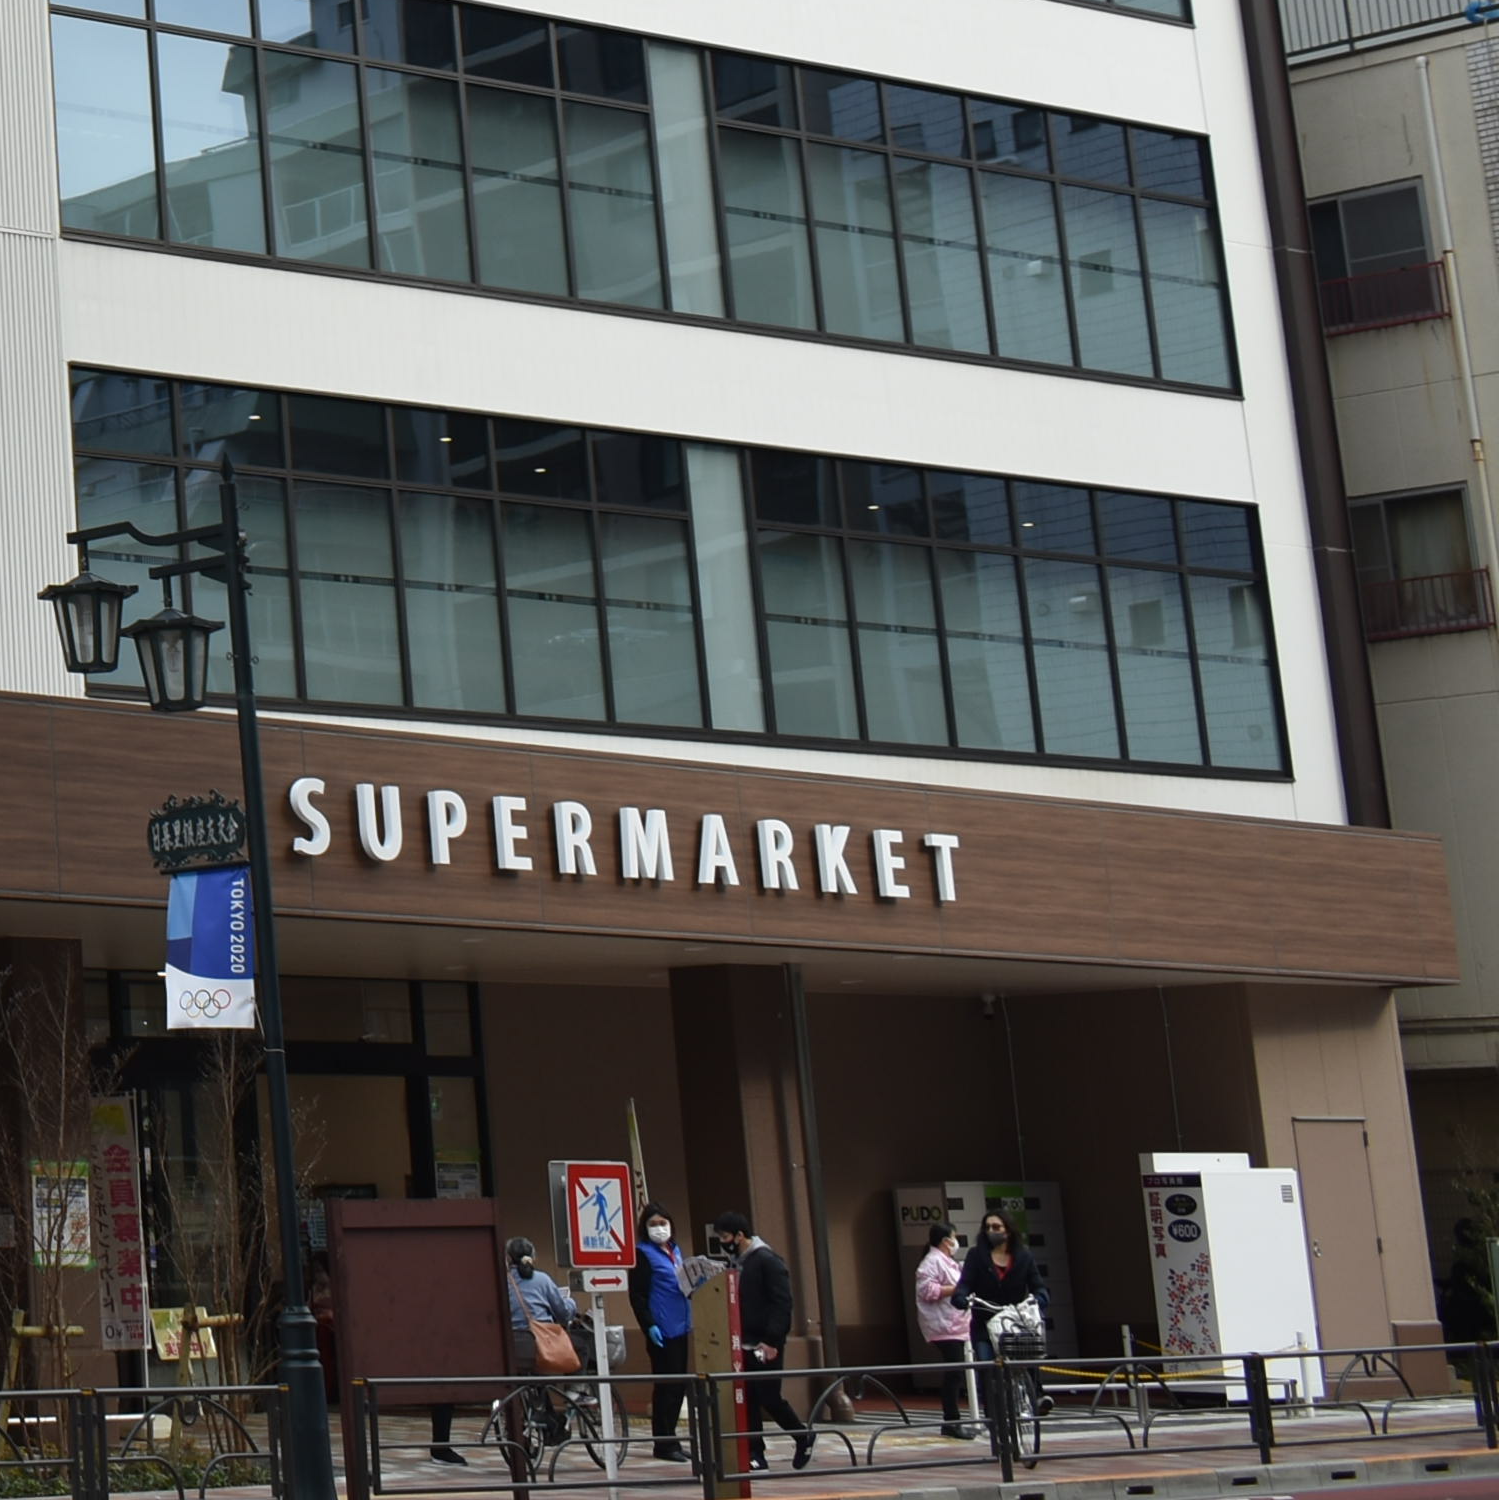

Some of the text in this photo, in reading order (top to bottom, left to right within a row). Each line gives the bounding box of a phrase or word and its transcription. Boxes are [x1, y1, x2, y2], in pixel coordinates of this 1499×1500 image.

[289, 777, 960, 902] SUPERMARKET
[230, 878, 246, 974] TOKYO 2020
[902, 1206, 942, 1221] PUDO
[1148, 1191, 1167, 1259] 証明写真
[1172, 1223, 1198, 1238] ¥600
